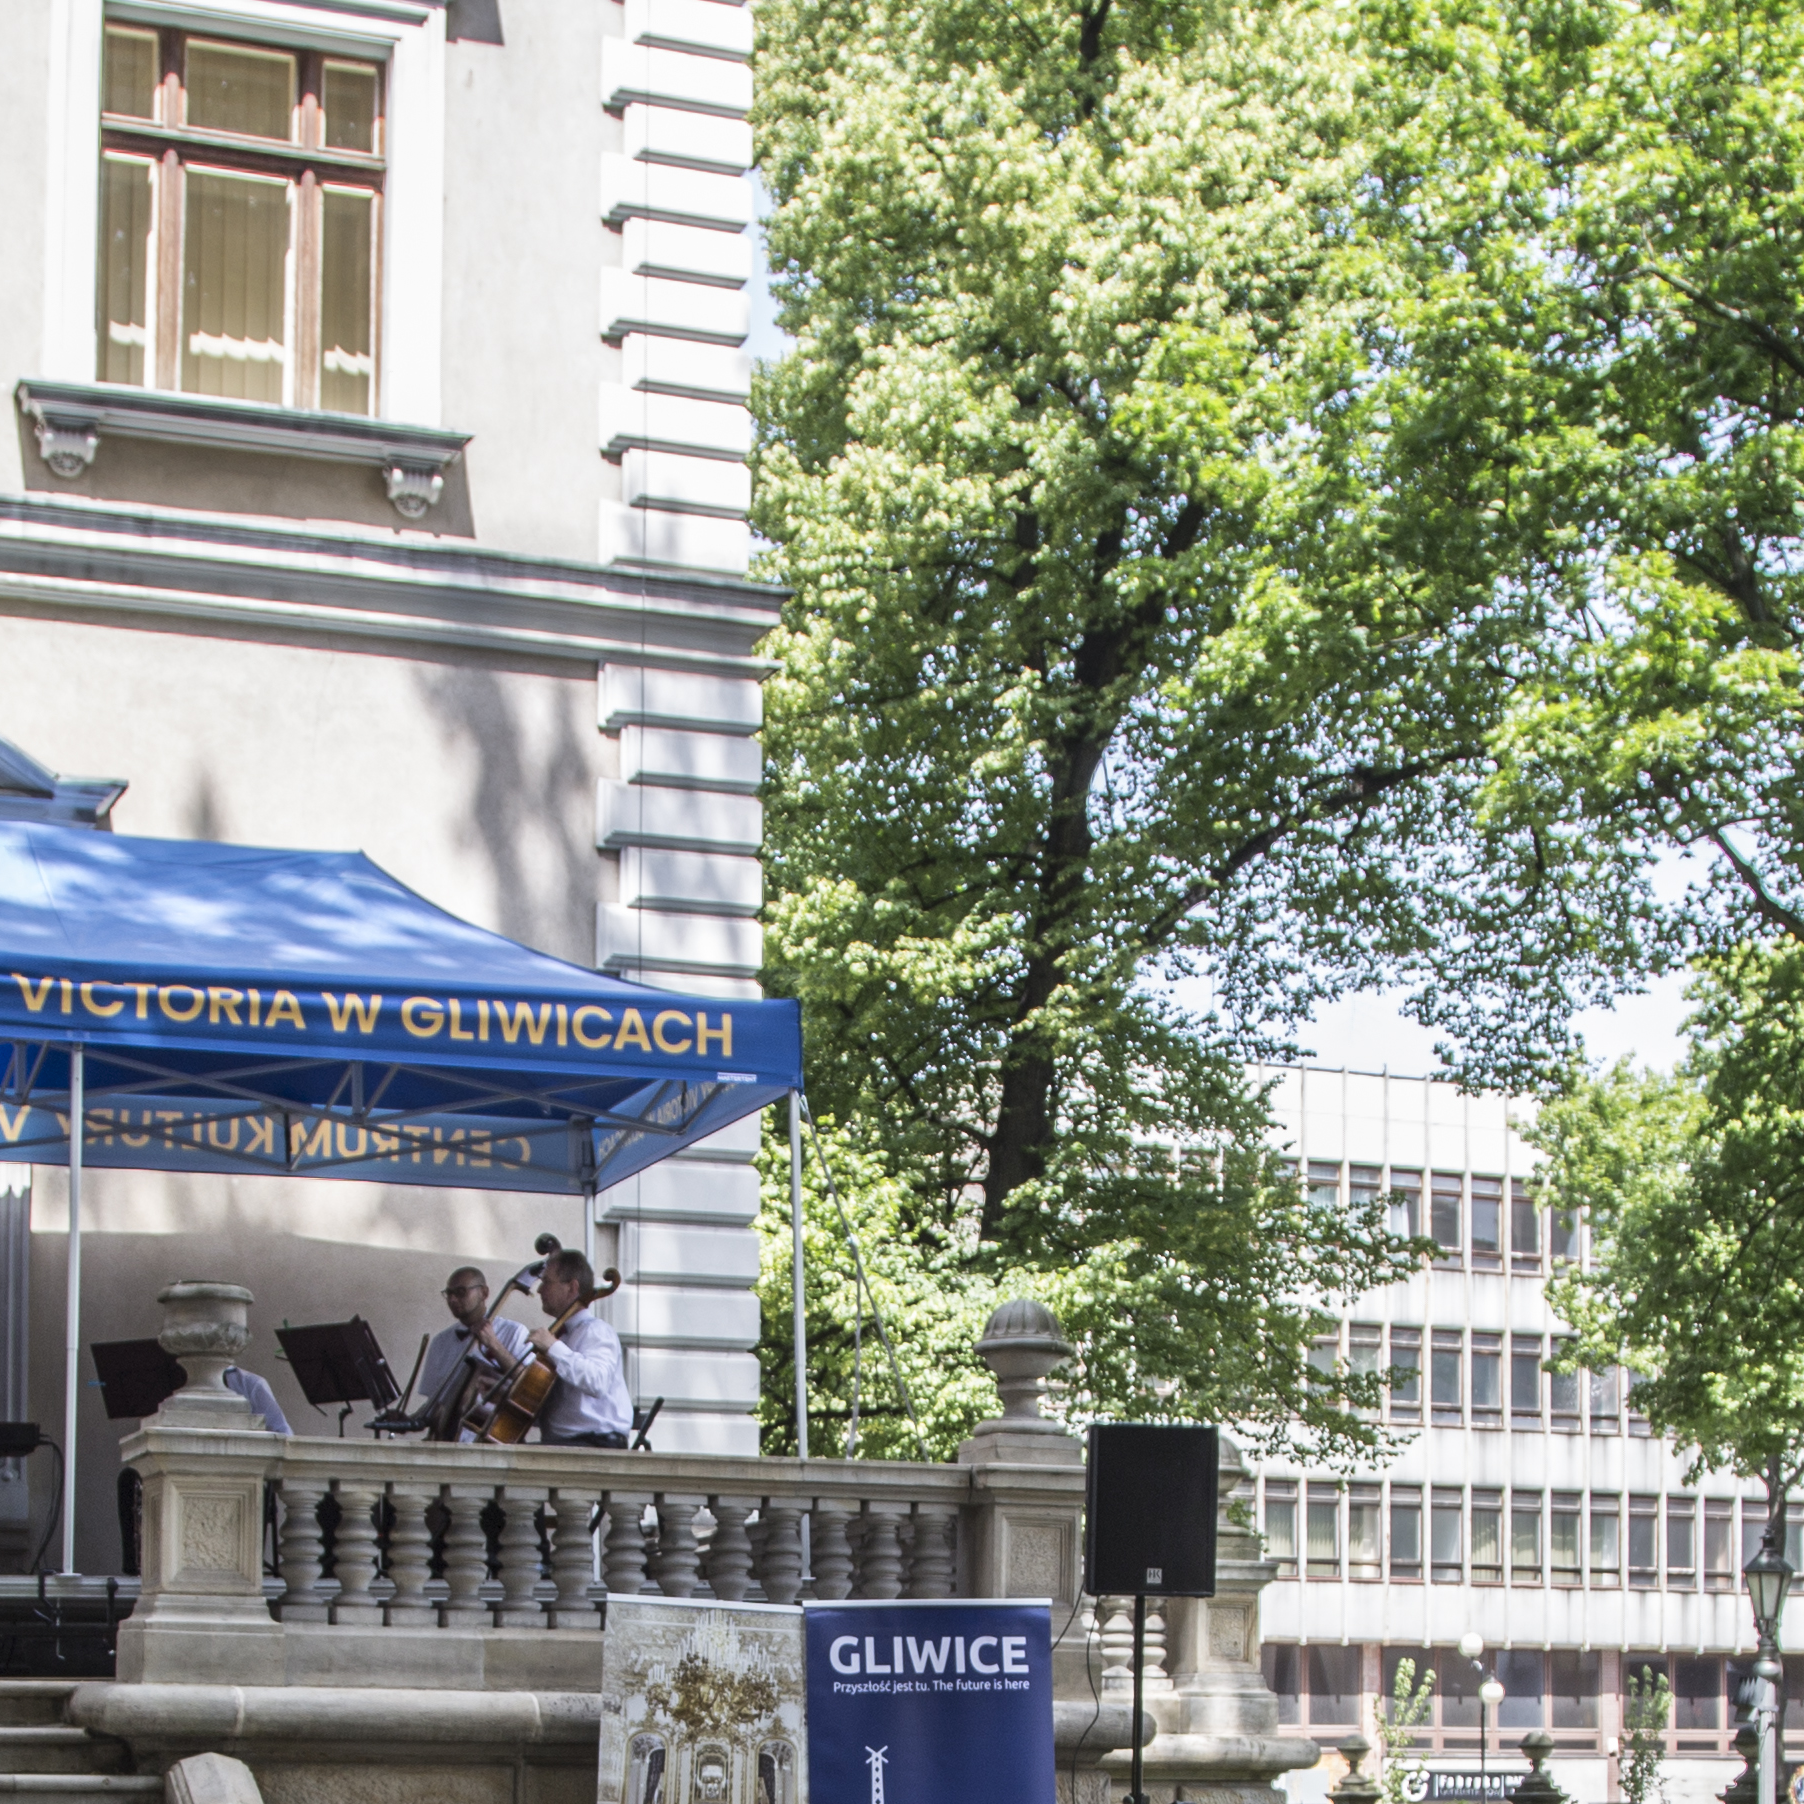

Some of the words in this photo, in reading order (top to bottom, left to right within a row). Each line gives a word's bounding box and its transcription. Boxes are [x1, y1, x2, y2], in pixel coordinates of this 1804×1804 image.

[11, 972, 307, 1030] VICTORIA
[321, 992, 383, 1034] W
[400, 996, 733, 1058] GLIWICACH
[829, 1635, 1030, 1675] GLIWICE
[833, 1680, 892, 1695] Przyszłość
[892, 1682, 914, 1695] jest
[915, 1681, 931, 1692] tu.
[933, 1679, 954, 1692] The
[956, 1678, 991, 1692] future
[993, 1679, 1003, 1690] is
[1004, 1678, 1030, 1691] here
